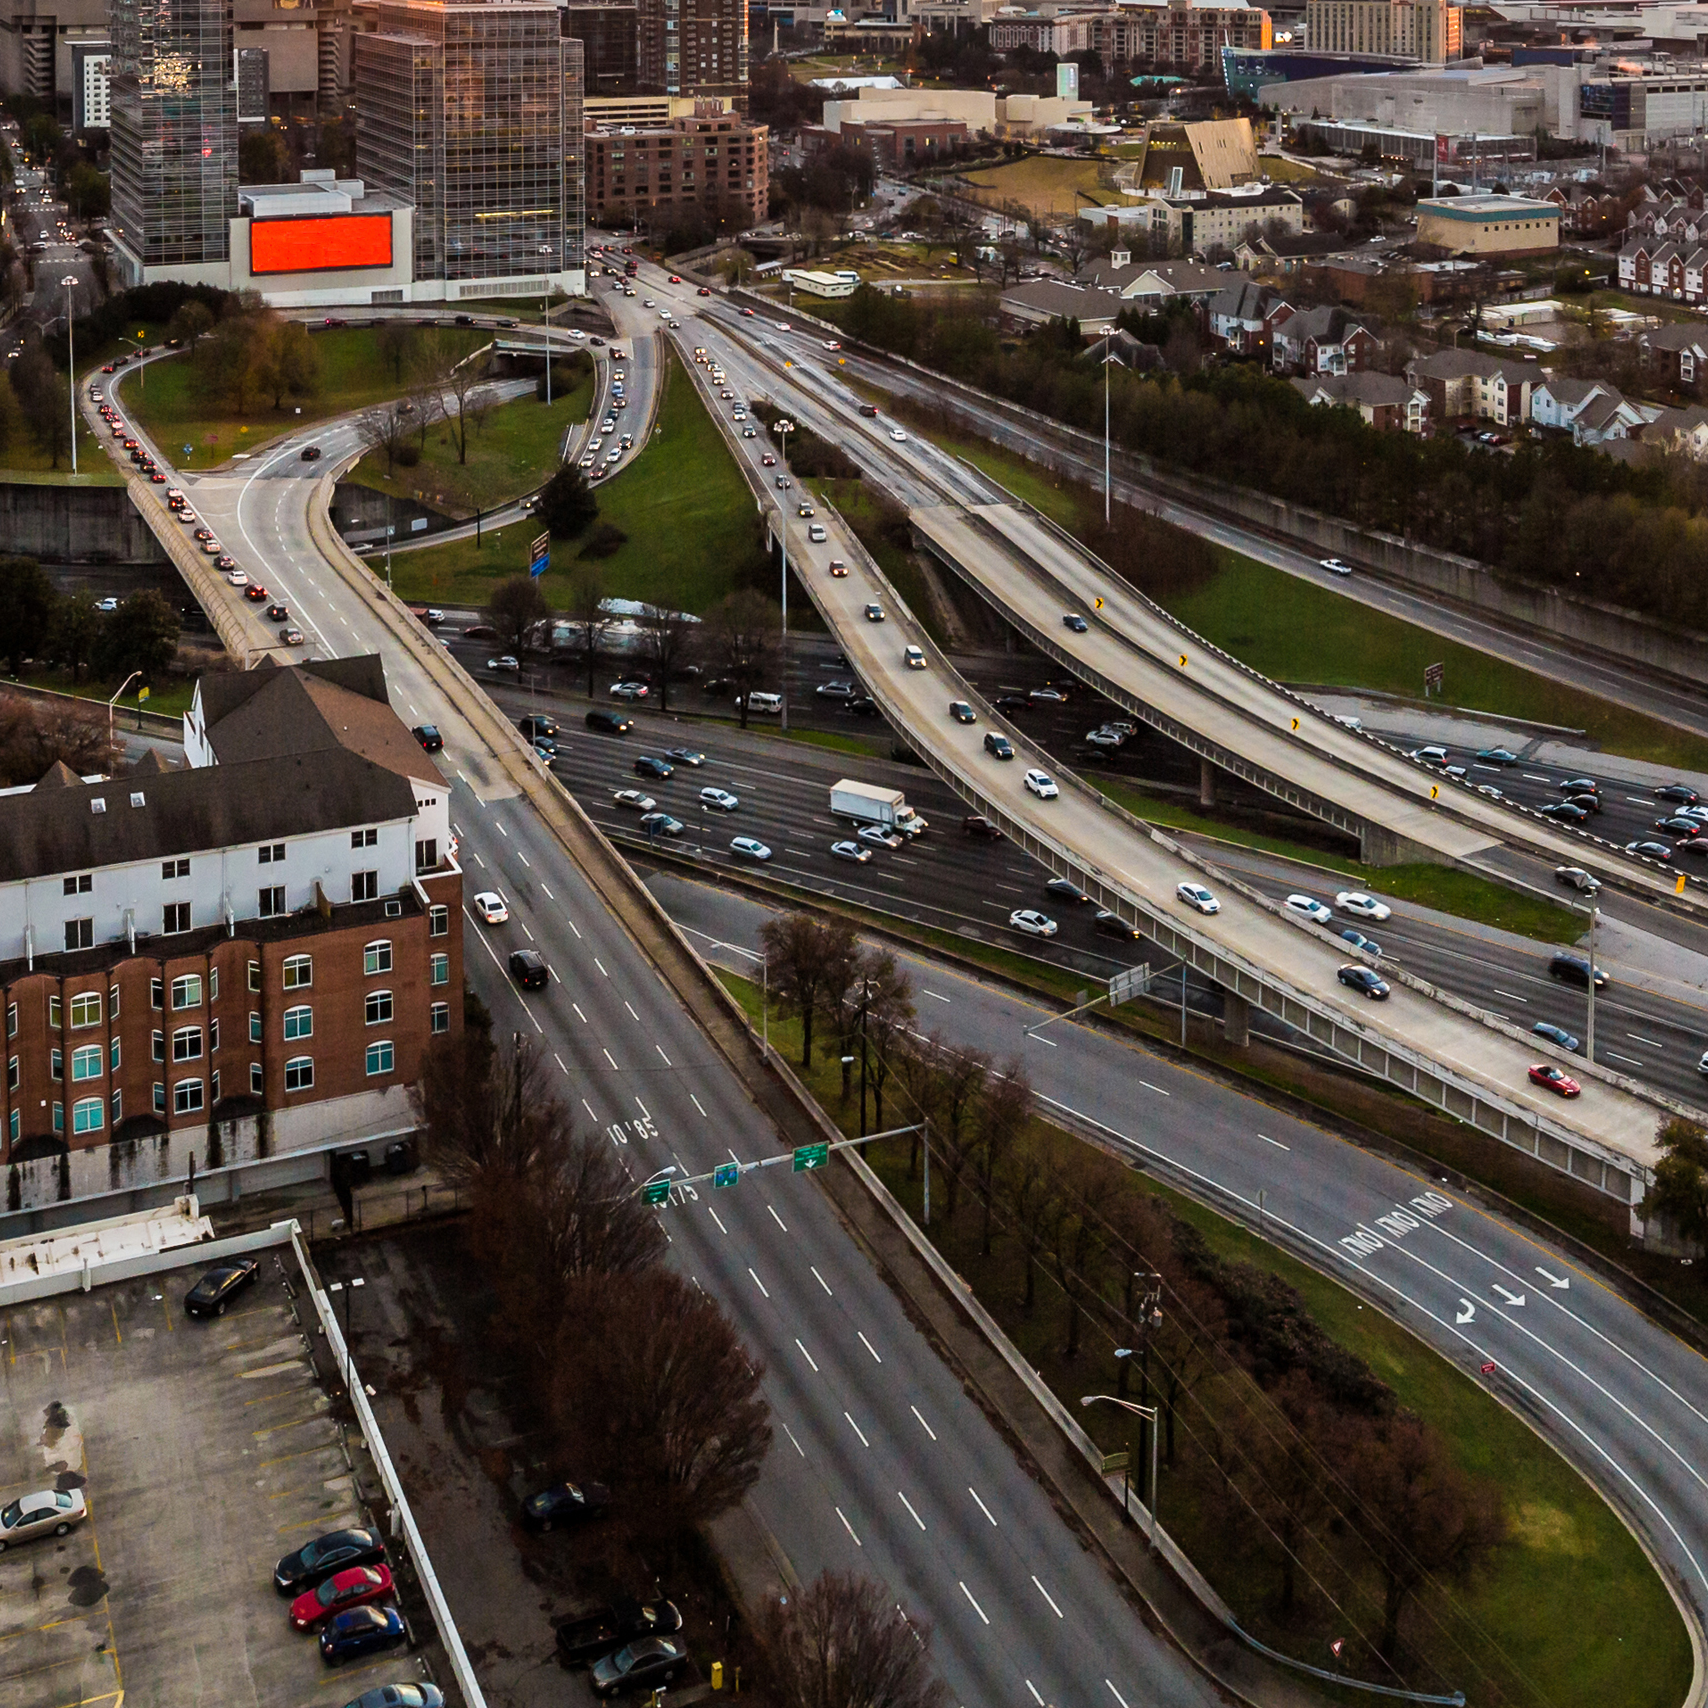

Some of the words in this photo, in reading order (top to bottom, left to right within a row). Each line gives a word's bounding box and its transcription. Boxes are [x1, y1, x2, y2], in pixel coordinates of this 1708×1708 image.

[1409, 1191, 1453, 1218] ONLY
[1374, 1211, 1420, 1239] ONLY
[1337, 1231, 1384, 1259] ONLY
